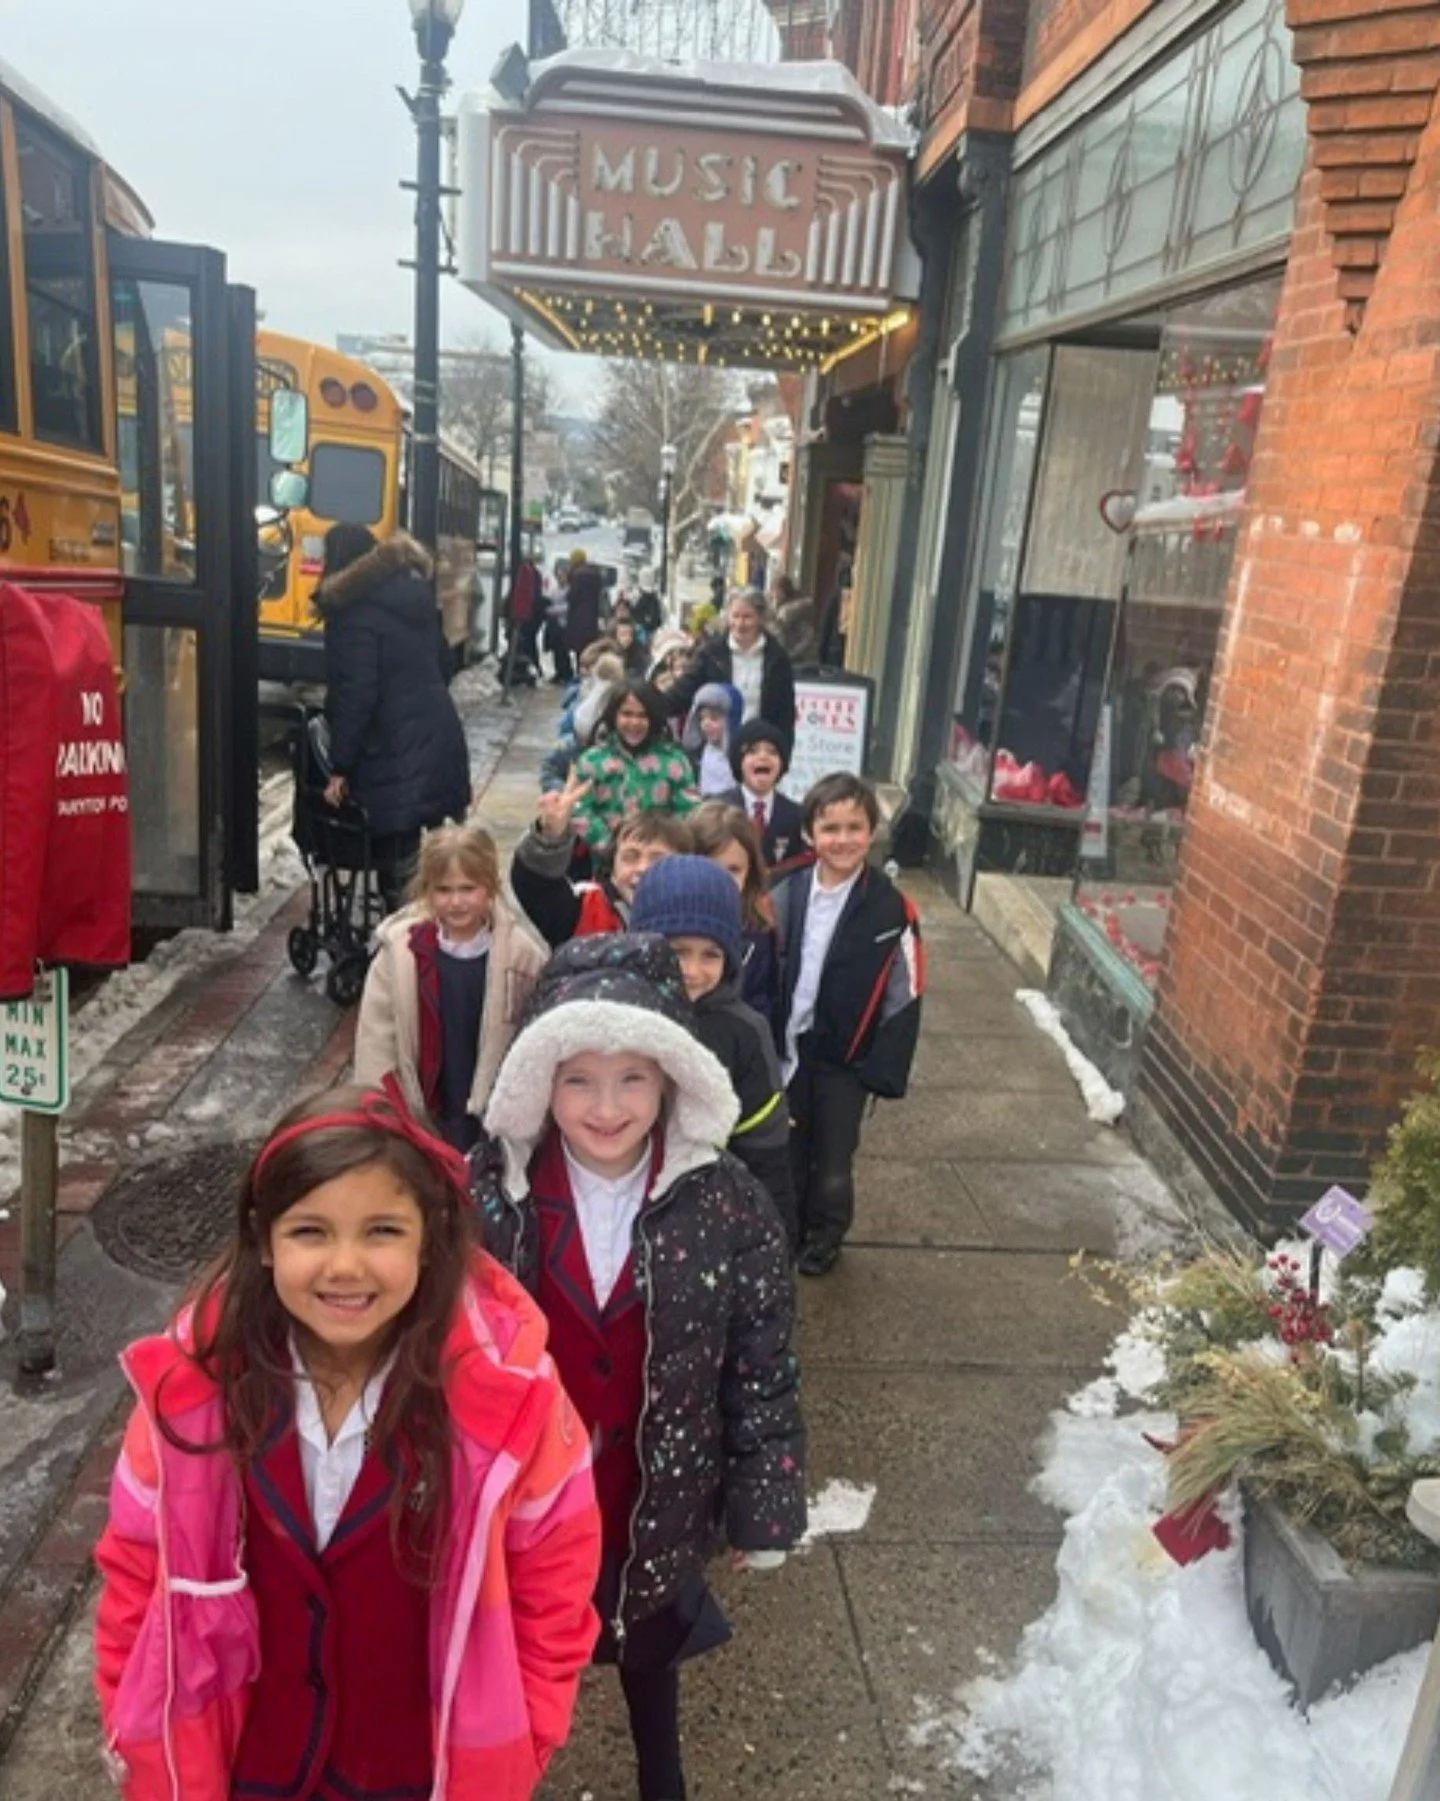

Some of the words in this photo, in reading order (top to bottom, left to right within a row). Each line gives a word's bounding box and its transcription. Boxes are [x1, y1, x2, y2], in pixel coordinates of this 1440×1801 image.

[592, 144, 802, 210] MUSIC
[584, 211, 802, 278] HALL
[6, 1000, 44, 1026] MIN
[5, 1032, 46, 1060] MAX
